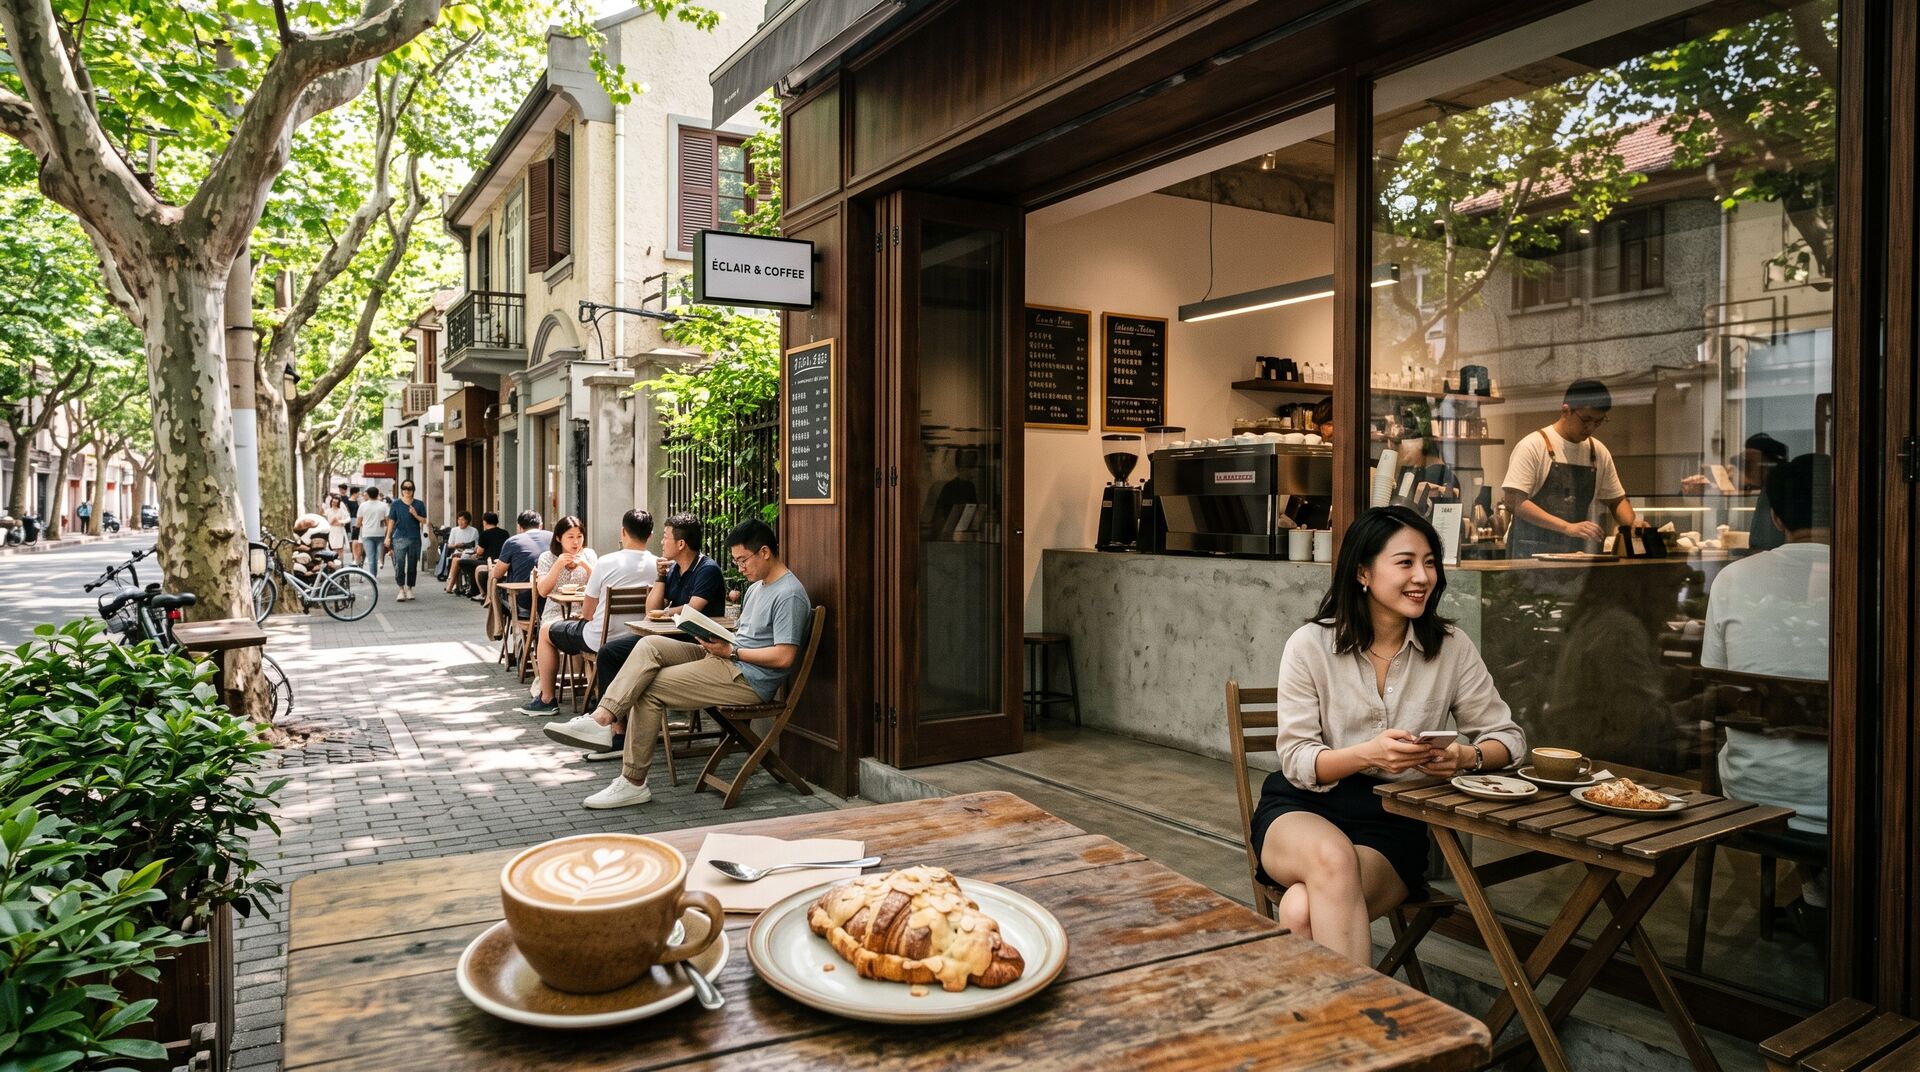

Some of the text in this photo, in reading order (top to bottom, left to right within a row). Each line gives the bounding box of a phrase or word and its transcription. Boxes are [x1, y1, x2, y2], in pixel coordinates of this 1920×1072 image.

[712, 258, 805, 279] ÉCLAIR & COFFEE
